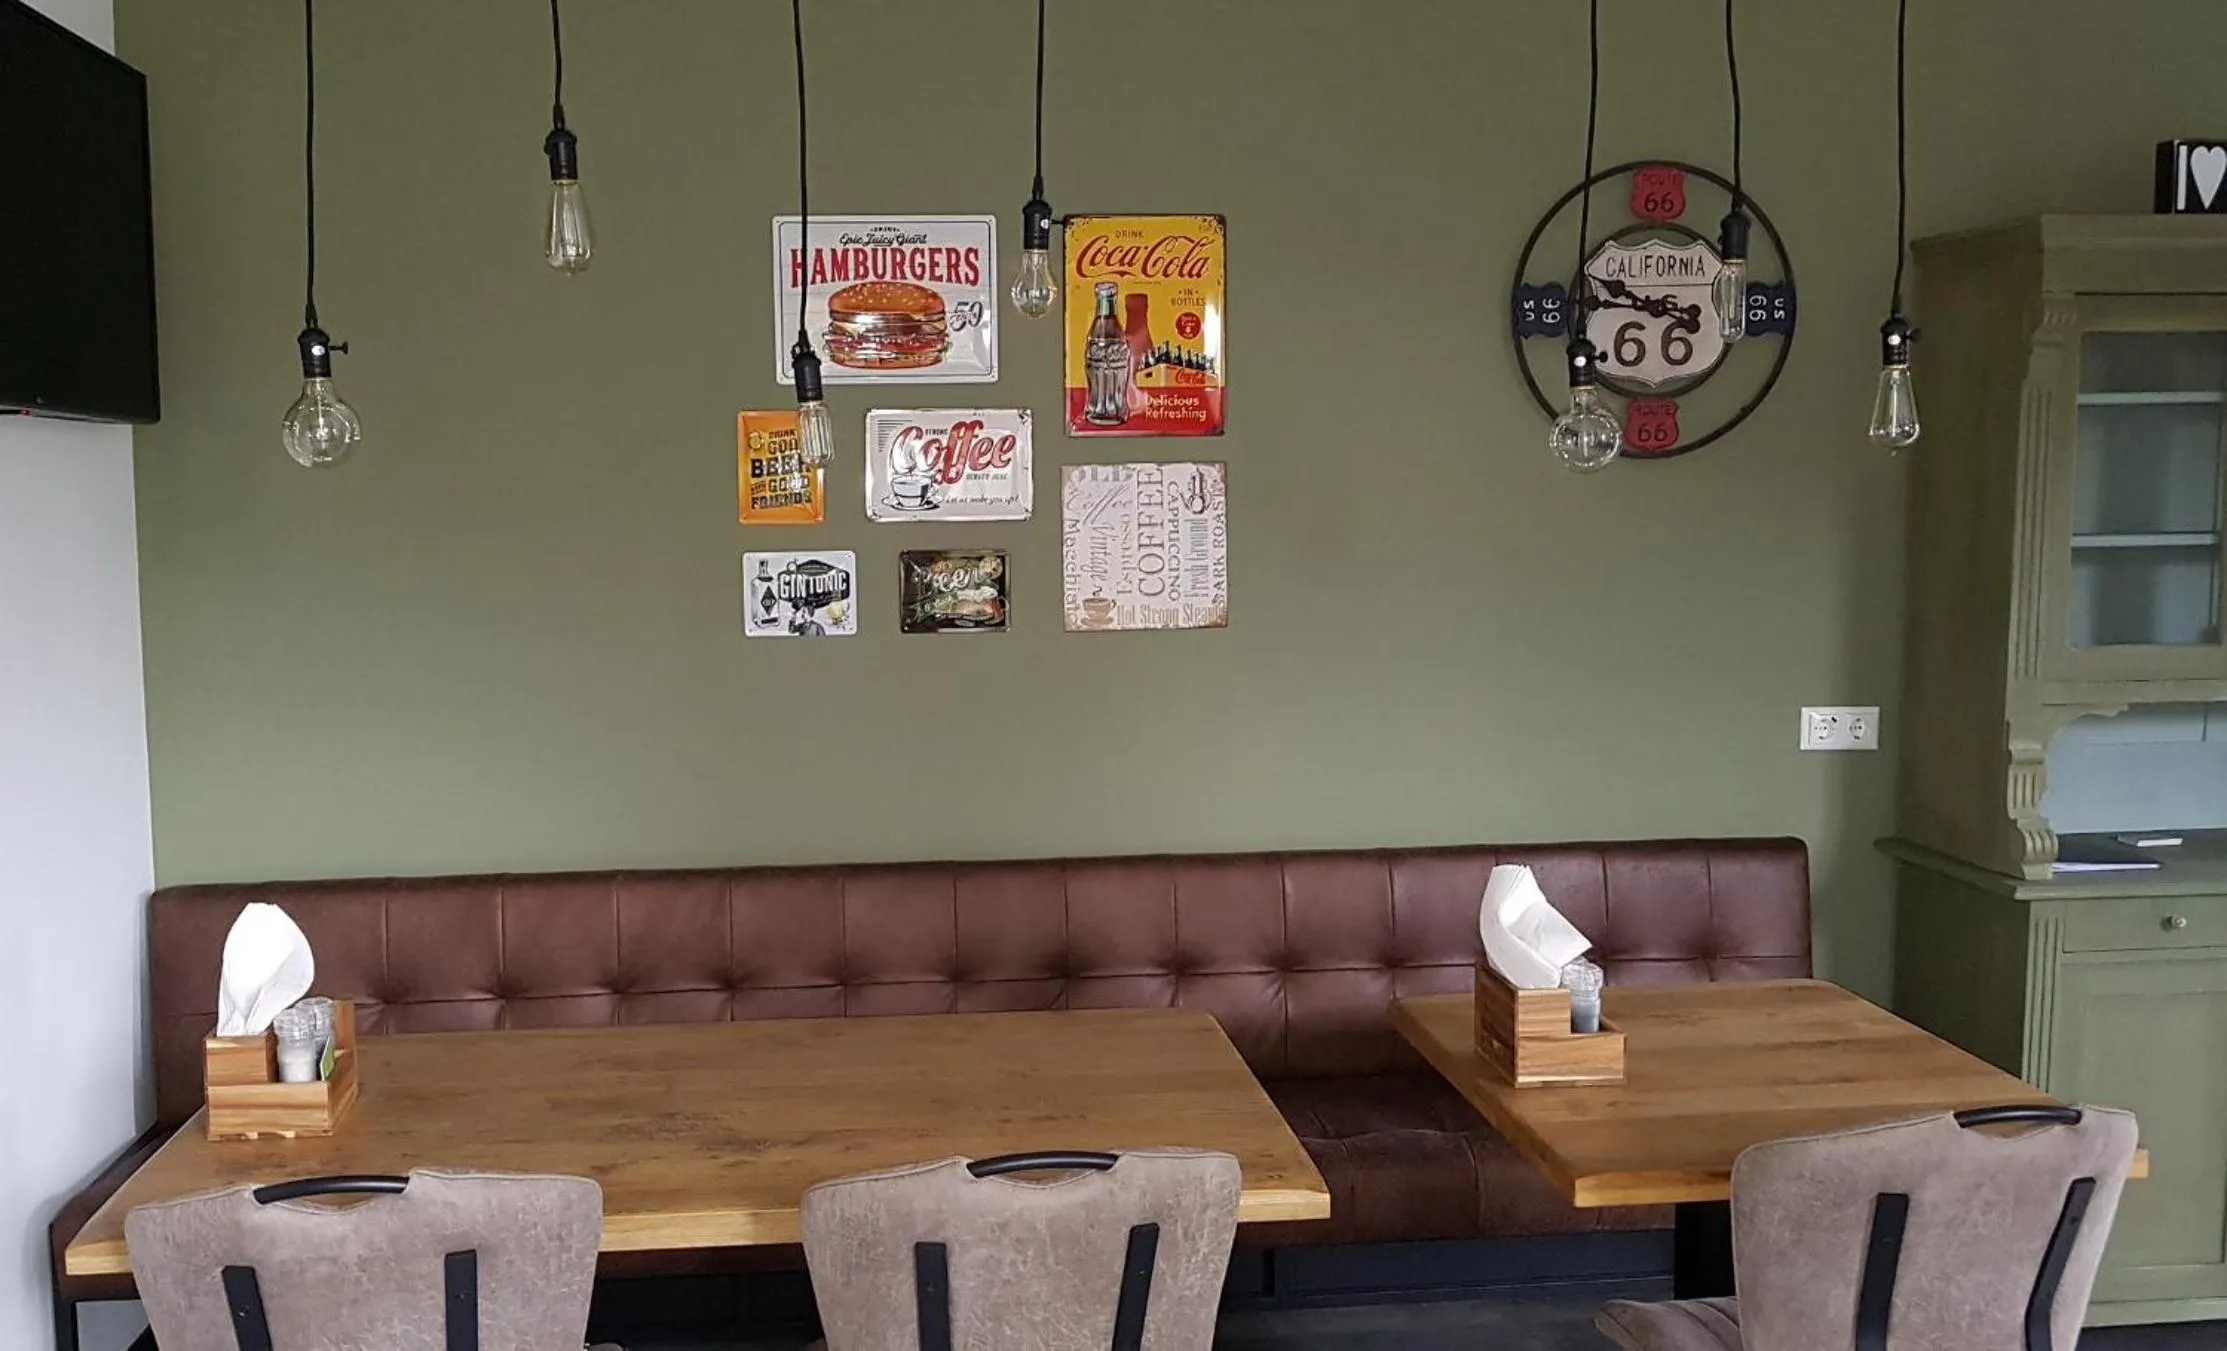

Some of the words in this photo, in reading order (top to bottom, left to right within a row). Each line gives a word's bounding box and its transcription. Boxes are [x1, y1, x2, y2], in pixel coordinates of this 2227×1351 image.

[1644, 191, 1674, 213] 66
[839, 233, 863, 246] Epic
[863, 233, 895, 247] Juicy
[895, 232, 927, 246] Giant
[1115, 230, 1144, 239] DRINK
[790, 248, 980, 288] HAMBURGERS
[1605, 254, 1706, 278] CALIFORNIA
[1171, 297, 1206, 307] BOTTLES
[1184, 287, 1193, 297] IN
[1523, 299, 1535, 322] US
[1542, 297, 1561, 323] 66
[1749, 295, 1767, 322] 66
[1774, 297, 1786, 320] US
[1613, 320, 1694, 367] 66
[1145, 394, 1200, 406] Delicious
[1145, 406, 1207, 422] Refreshing
[768, 429, 796, 439] DRINK
[1638, 422, 1668, 442] 66
[890, 419, 1017, 485] Coffee
[751, 491, 812, 510] FRIENDS
[1137, 468, 1165, 597] COFFEE
[1167, 480, 1182, 601] CAPPUCCINO
